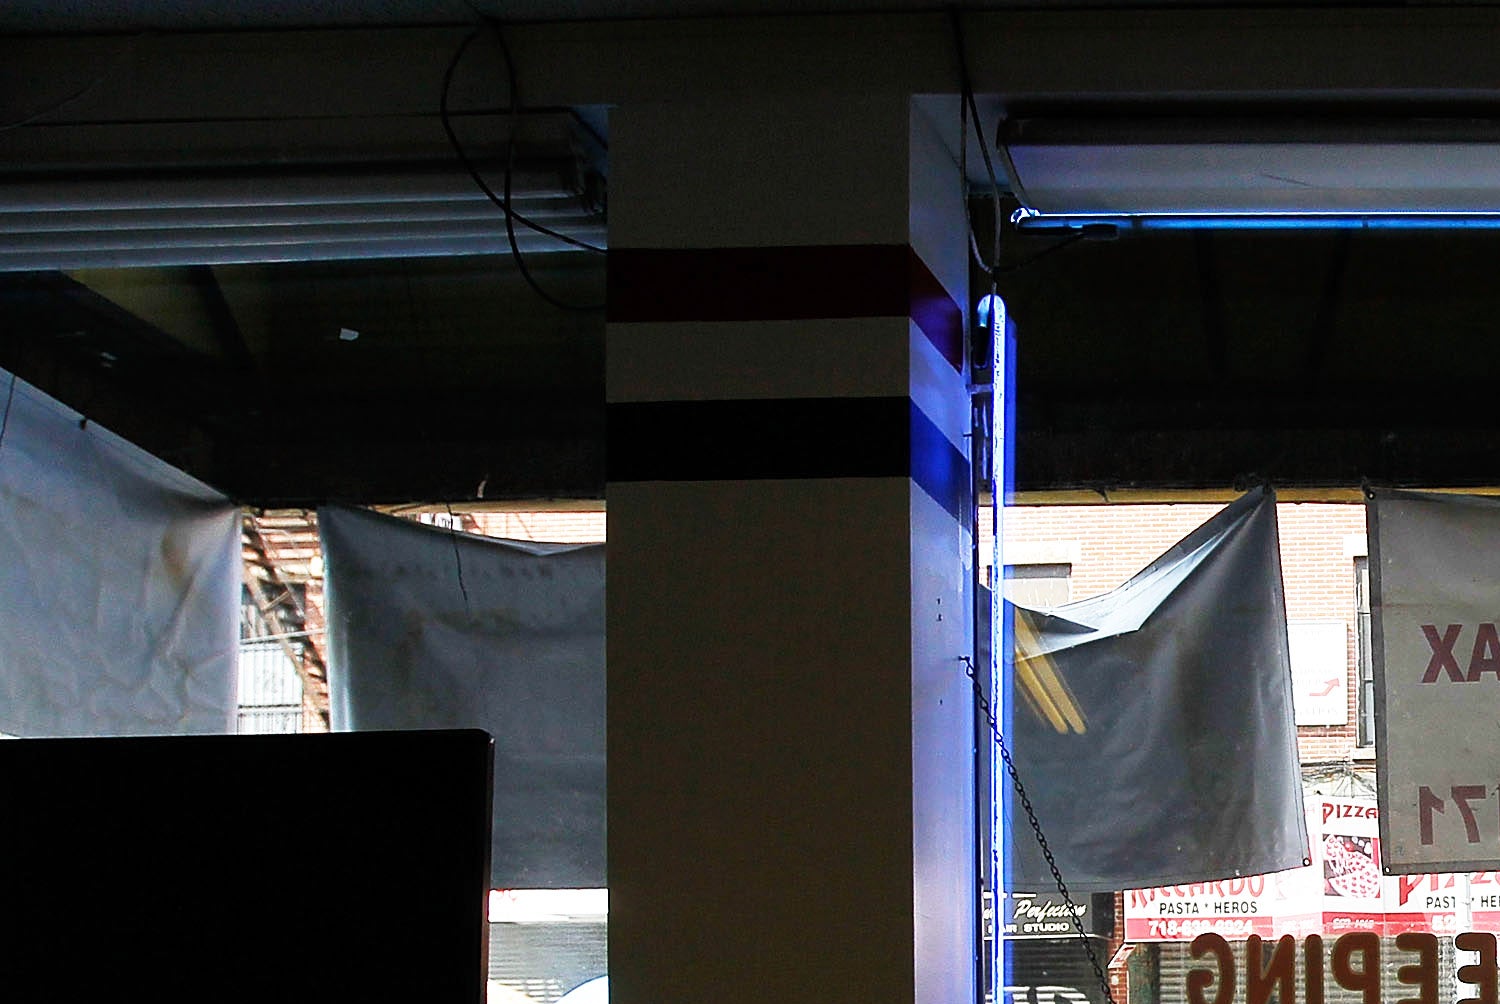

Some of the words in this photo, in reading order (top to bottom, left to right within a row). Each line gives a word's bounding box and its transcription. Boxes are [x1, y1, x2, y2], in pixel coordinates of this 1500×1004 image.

[1321, 802, 1379, 826] PIZZA
[1159, 901, 1200, 915] PASTA
[1213, 900, 1258, 914] HEROS
[1023, 922, 1071, 933] STUDIO
